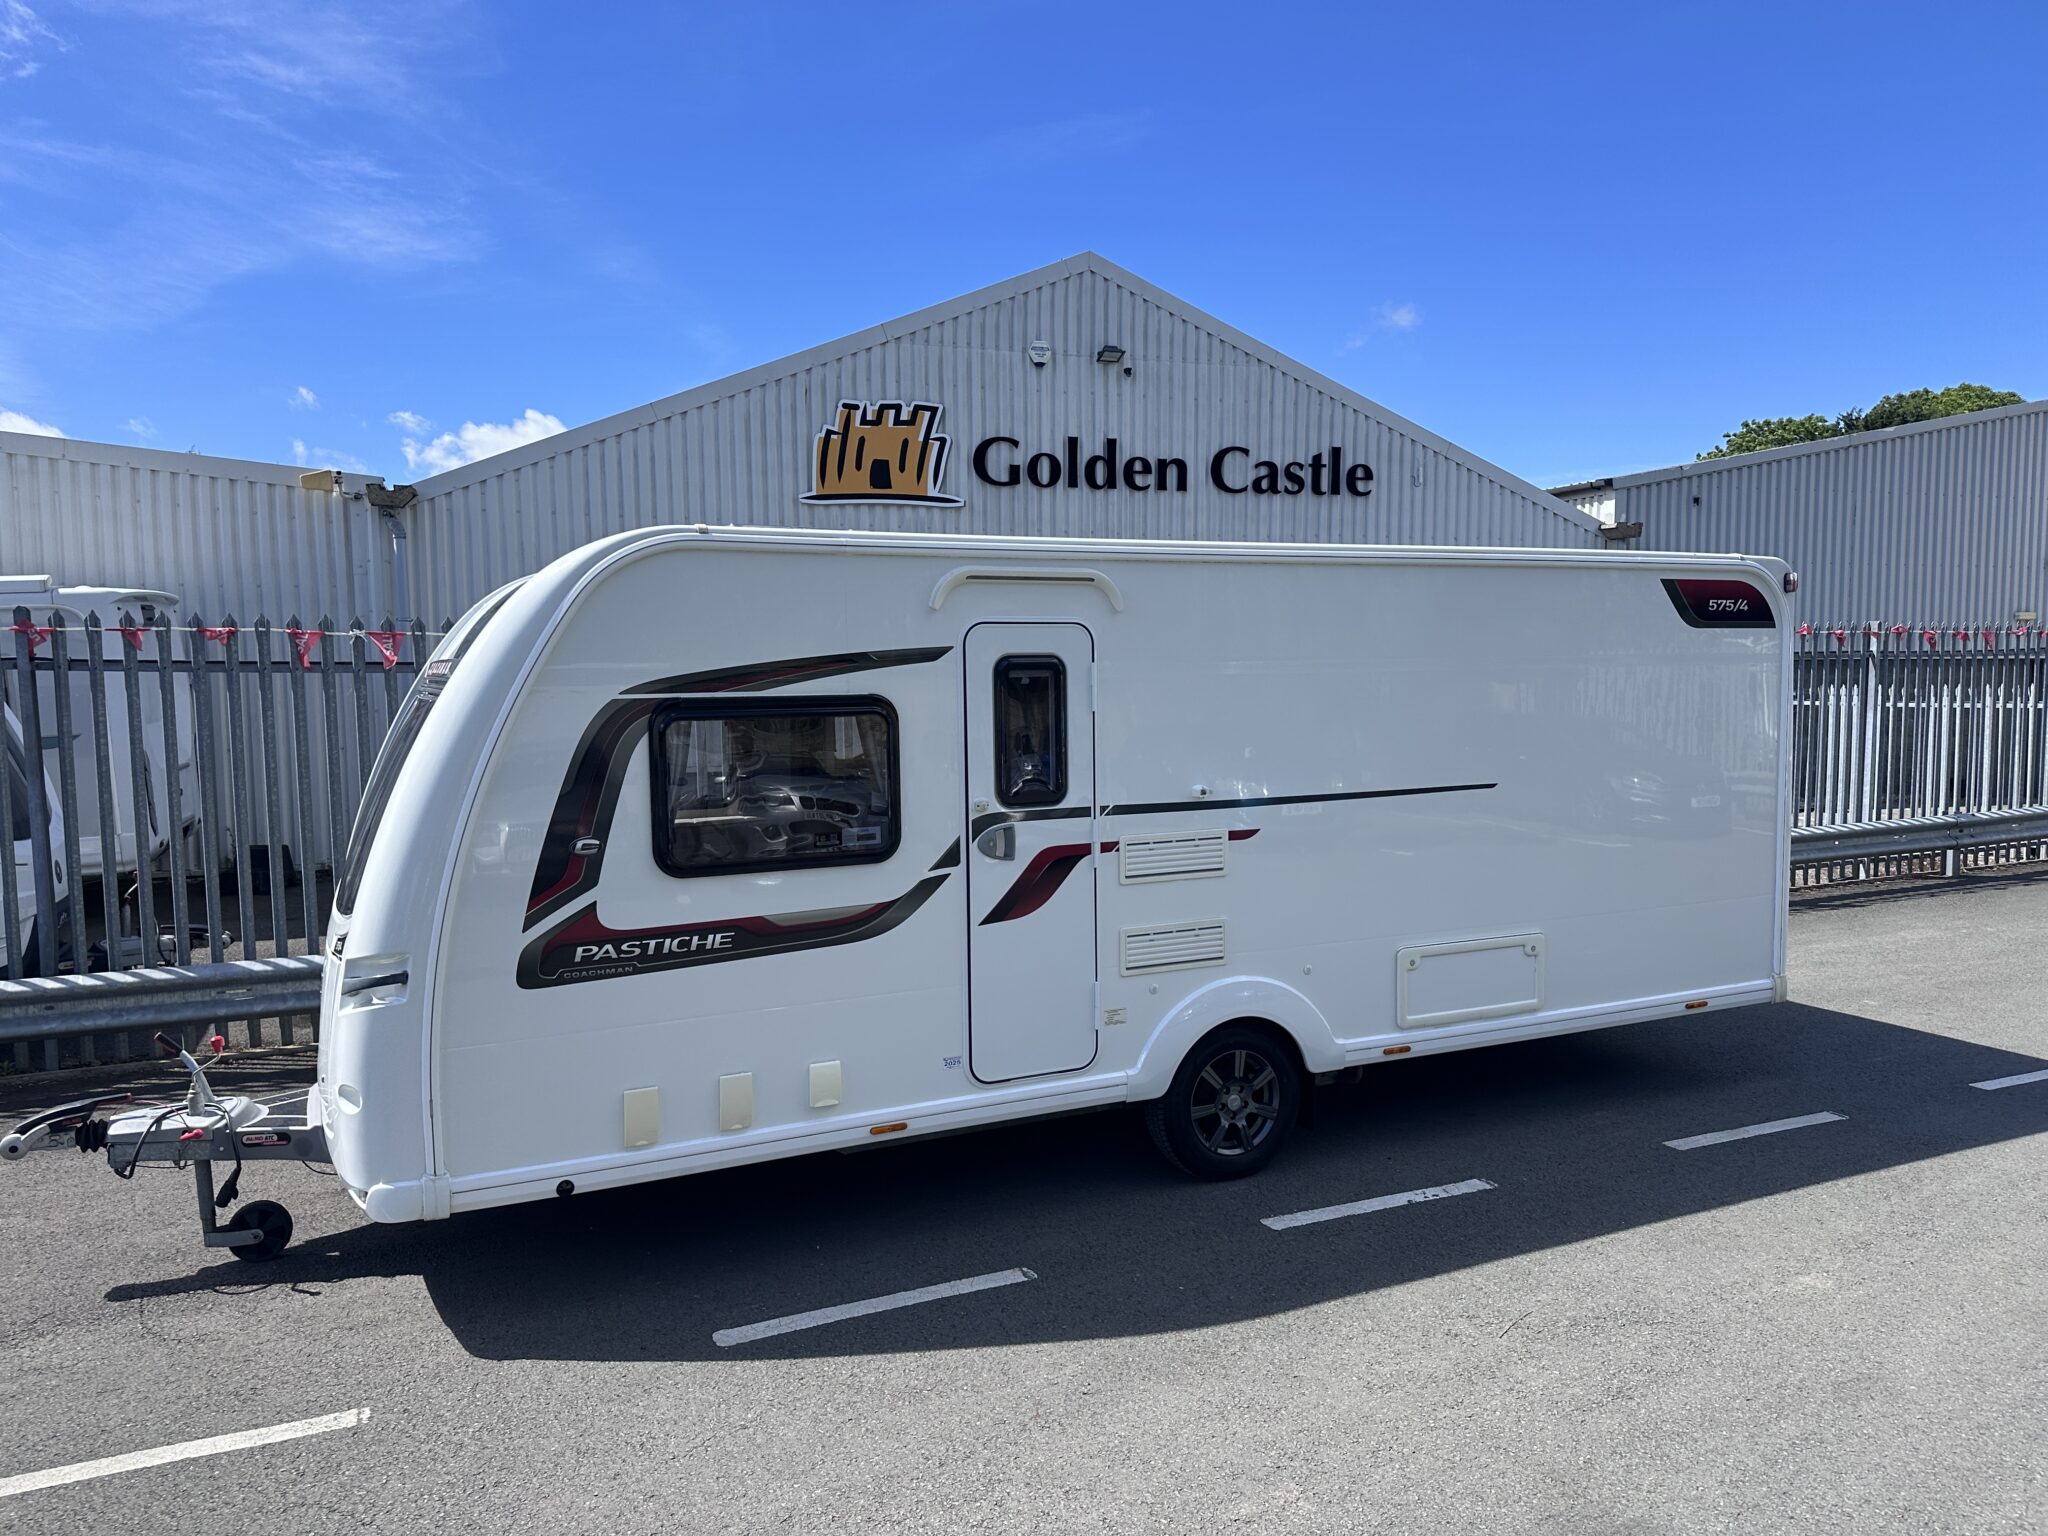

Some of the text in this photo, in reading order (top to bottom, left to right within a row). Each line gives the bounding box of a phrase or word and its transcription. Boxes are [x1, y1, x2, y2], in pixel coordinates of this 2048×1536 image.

[973, 436, 1374, 496] Golden Castle
[1708, 599, 1748, 612] 575/4
[574, 932, 735, 963] PASTICHE
[563, 966, 633, 979] COACHMAN
